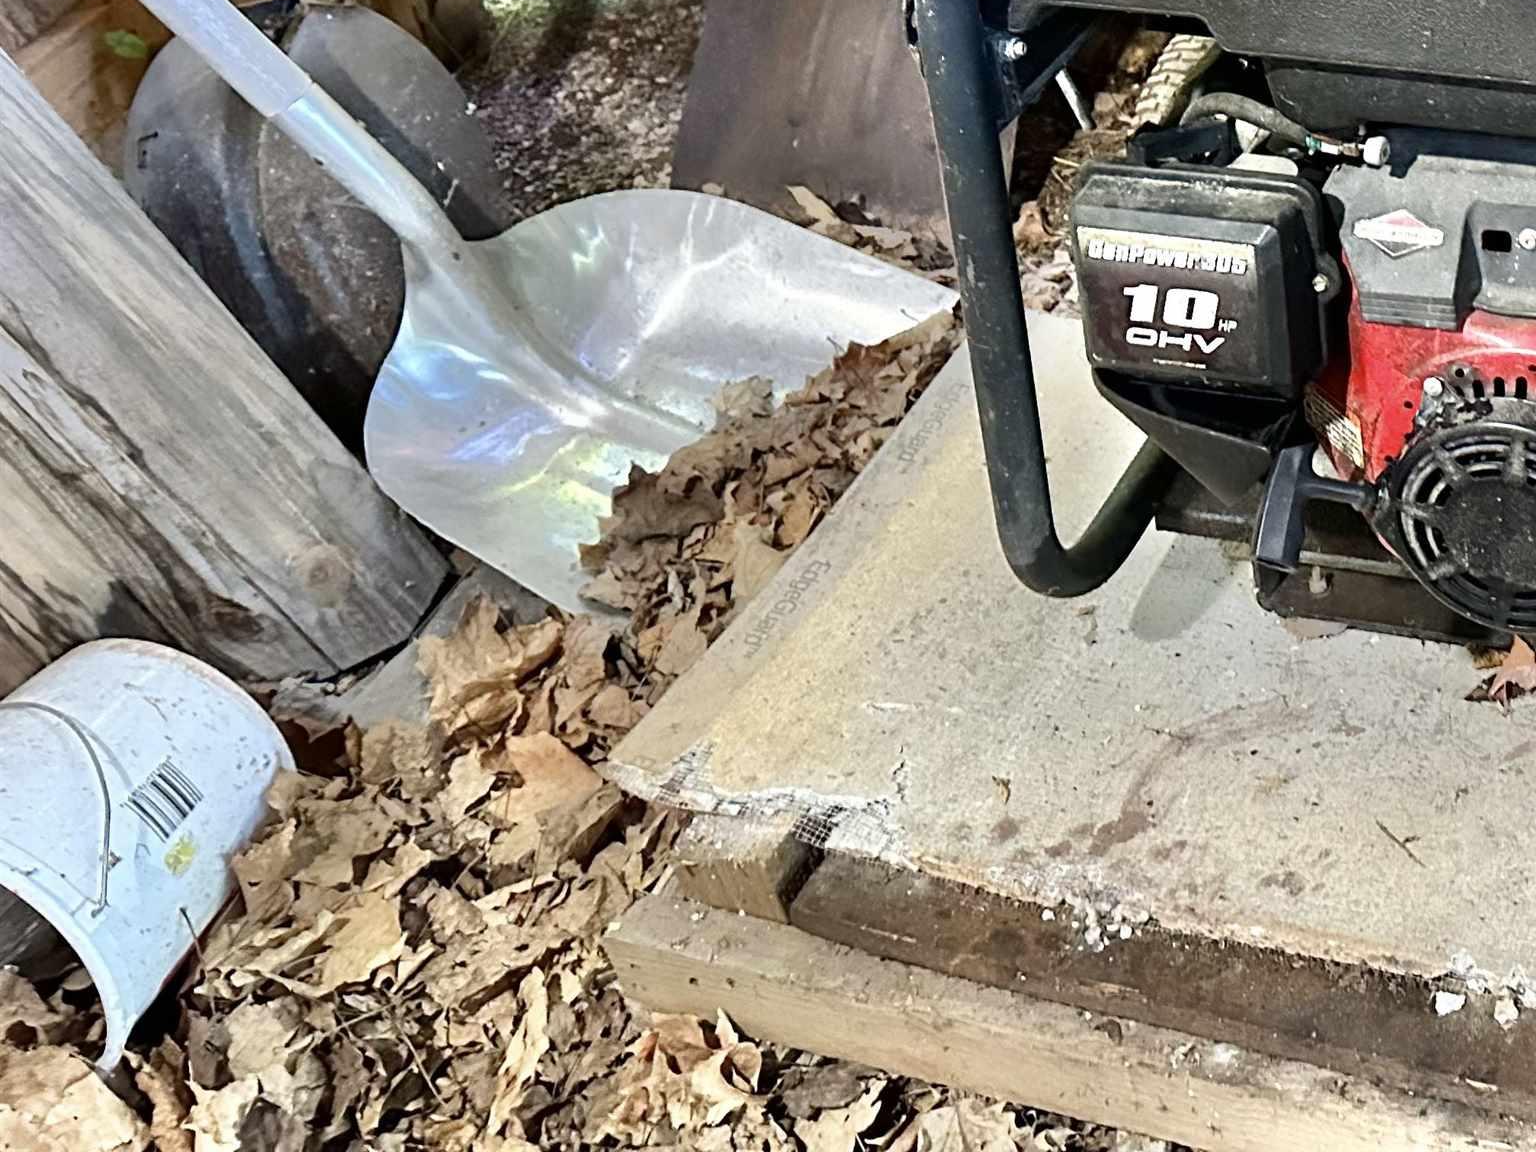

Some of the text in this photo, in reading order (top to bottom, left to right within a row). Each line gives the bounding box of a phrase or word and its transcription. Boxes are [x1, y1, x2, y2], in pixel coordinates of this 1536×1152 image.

[1123, 283, 1238, 333] 10 HP
[1126, 326, 1225, 354] OHV
